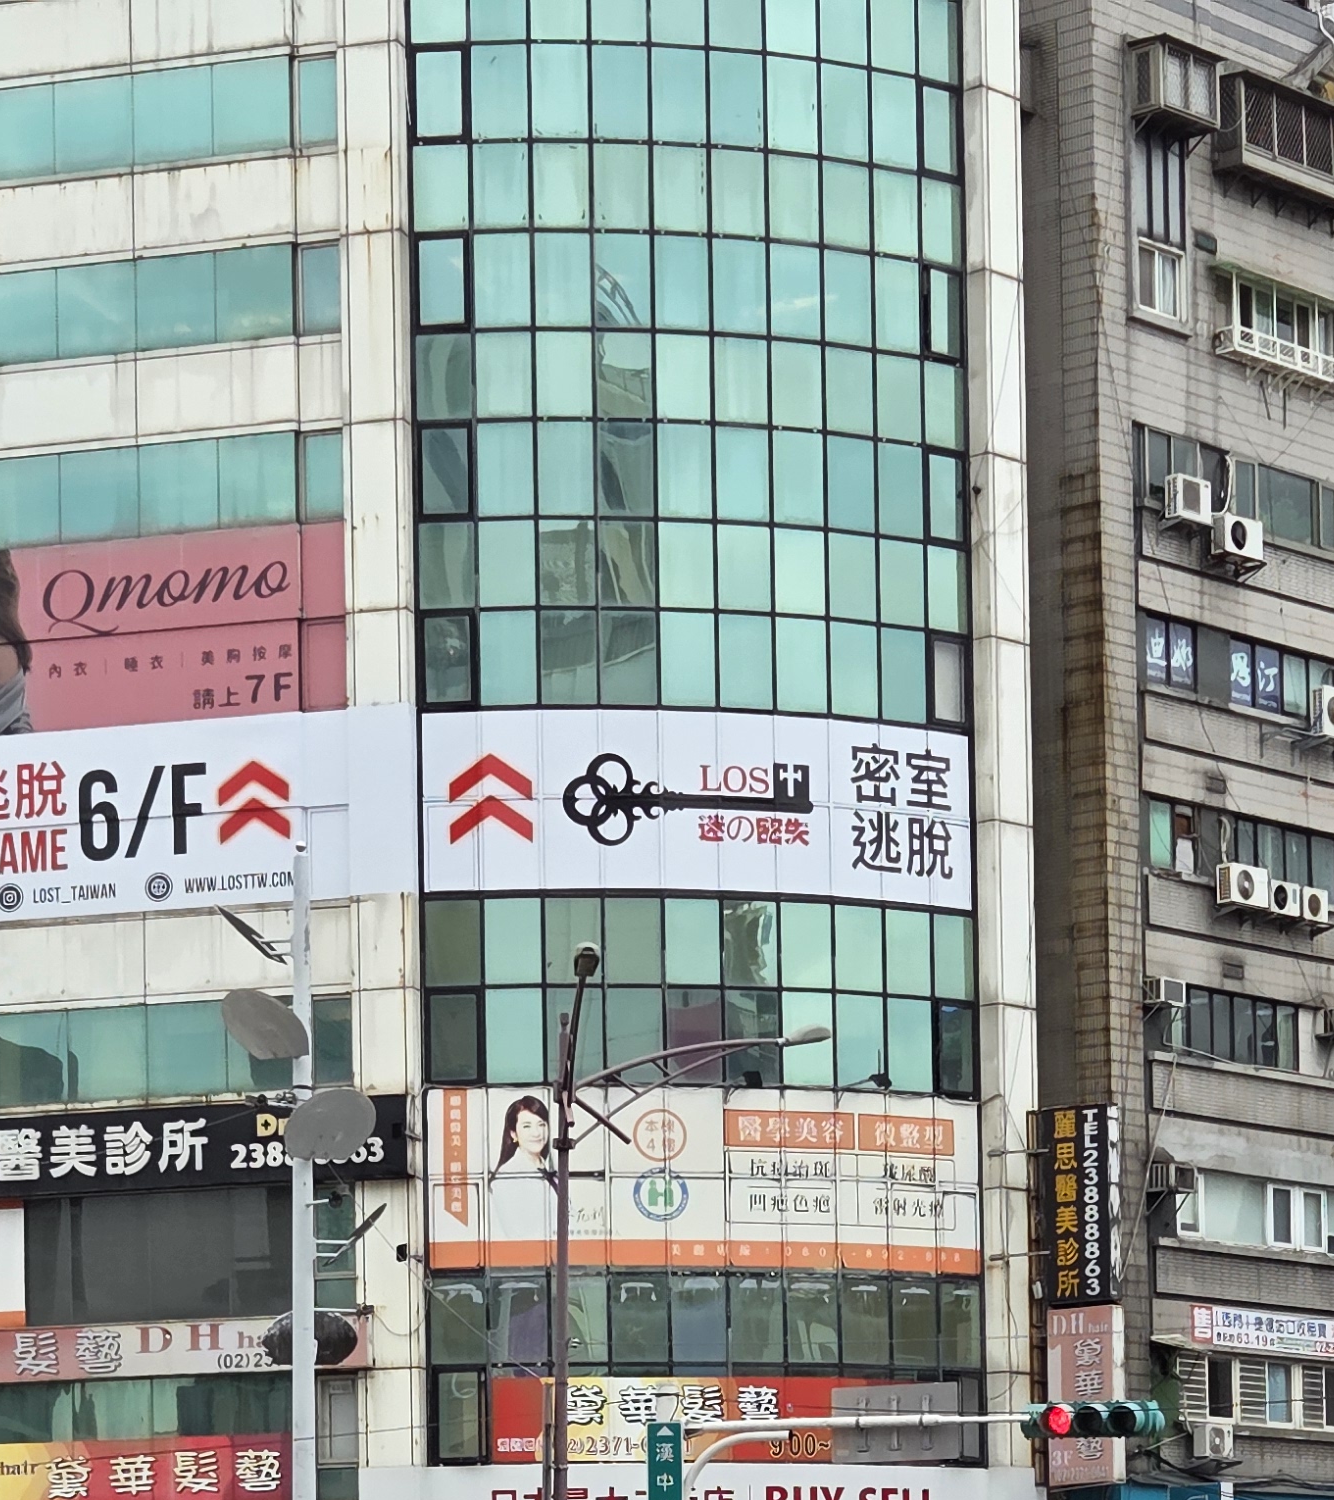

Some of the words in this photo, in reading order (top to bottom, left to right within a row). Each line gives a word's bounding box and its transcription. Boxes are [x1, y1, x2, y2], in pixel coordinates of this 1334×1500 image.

[42, 556, 291, 637] Qmomo
[47, 659, 89, 680] 內衣
[123, 654, 164, 673] 睡衣
[200, 642, 294, 668] 美胸按摩
[192, 671, 294, 711] 請上7F
[851, 743, 952, 814] 密室
[77, 761, 207, 862] 6/F
[852, 813, 954, 881] 逃脫
[32, 882, 117, 906] LOST_TAIWAN
[738, 1115, 845, 1145] 醫學美容
[875, 1120, 944, 1151] 微整型
[1052, 1108, 1080, 1300] 麗思醫美診所
[1081, 1108, 1101, 1297] TEL23888863
[1192, 1306, 1212, 1342] 售
[566, 1383, 780, 1424] 黛華髮藝
[1073, 1337, 1105, 1461] 黛華藝
[0, 1459, 38, 1477] hair
[45, 1446, 283, 1499] 黛華髮藝
